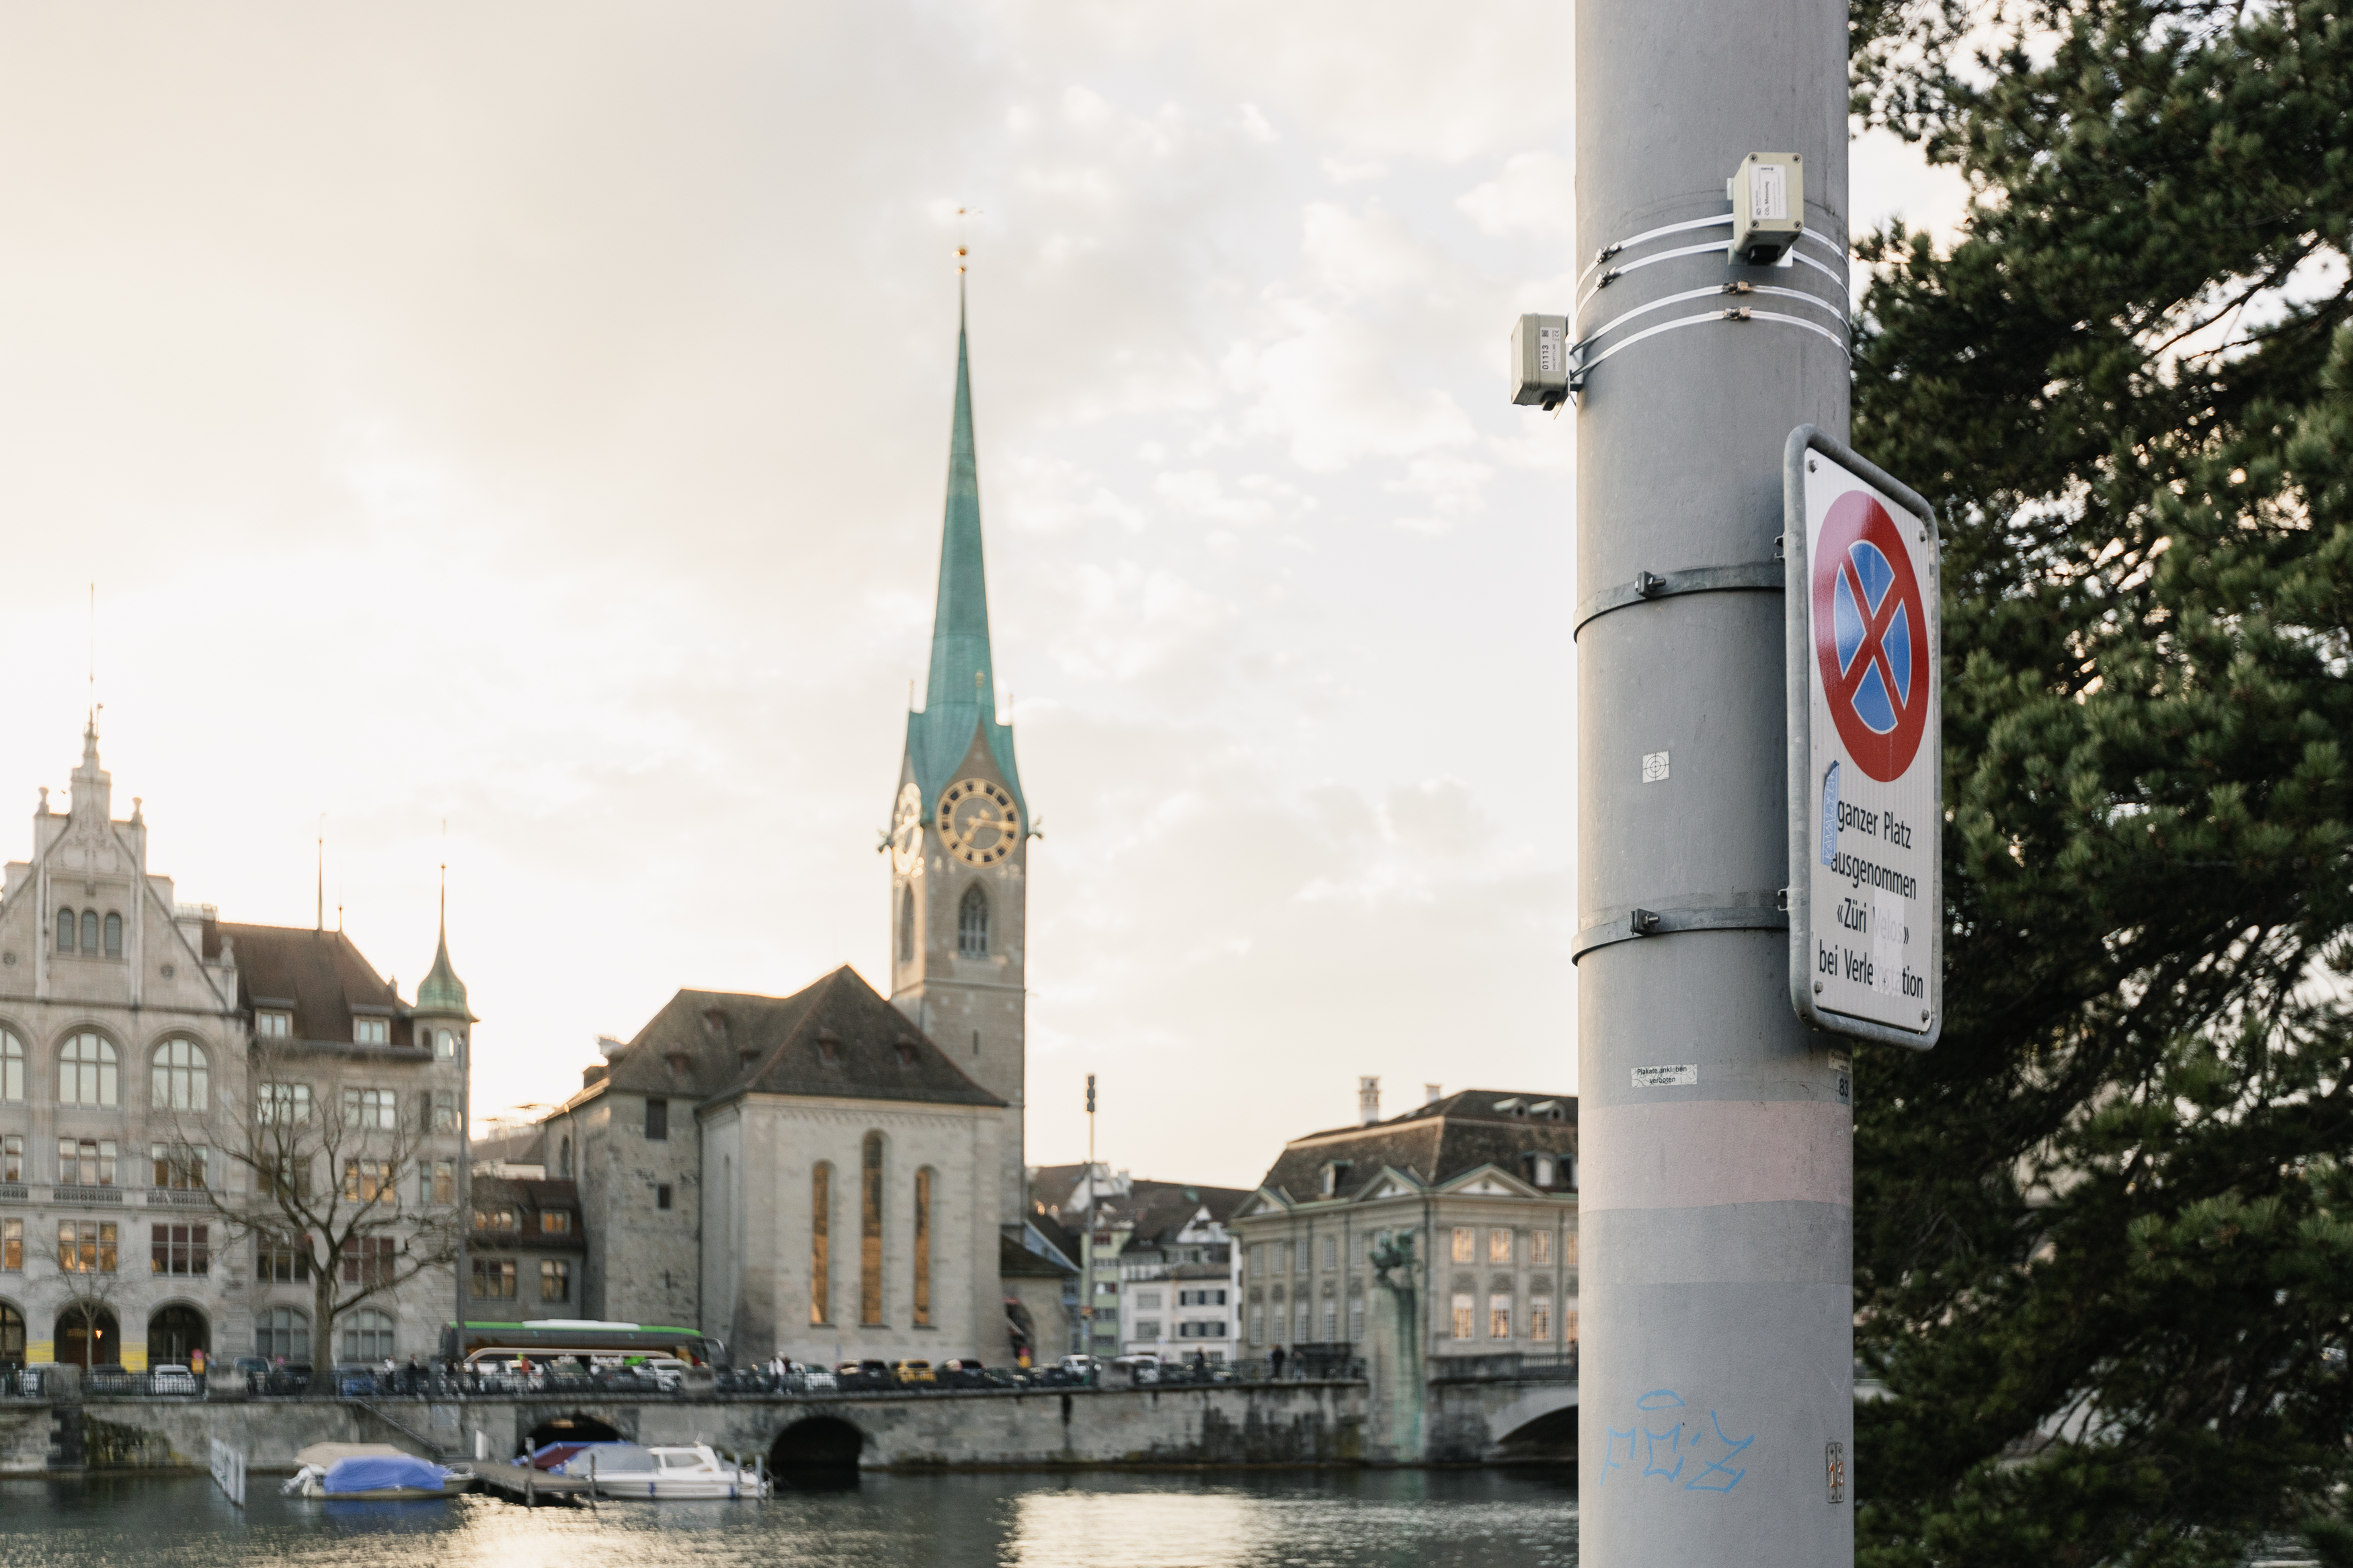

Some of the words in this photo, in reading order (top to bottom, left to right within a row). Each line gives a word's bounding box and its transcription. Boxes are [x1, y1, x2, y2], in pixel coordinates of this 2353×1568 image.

[1837, 799, 1878, 836] ganzer
[1884, 811, 1911, 850] Platz
[1831, 851, 1917, 901] ausgenommen
[1837, 897, 1867, 934] «Züri
[1819, 939, 1838, 977] bei
[1839, 1077, 1849, 1098] 83
